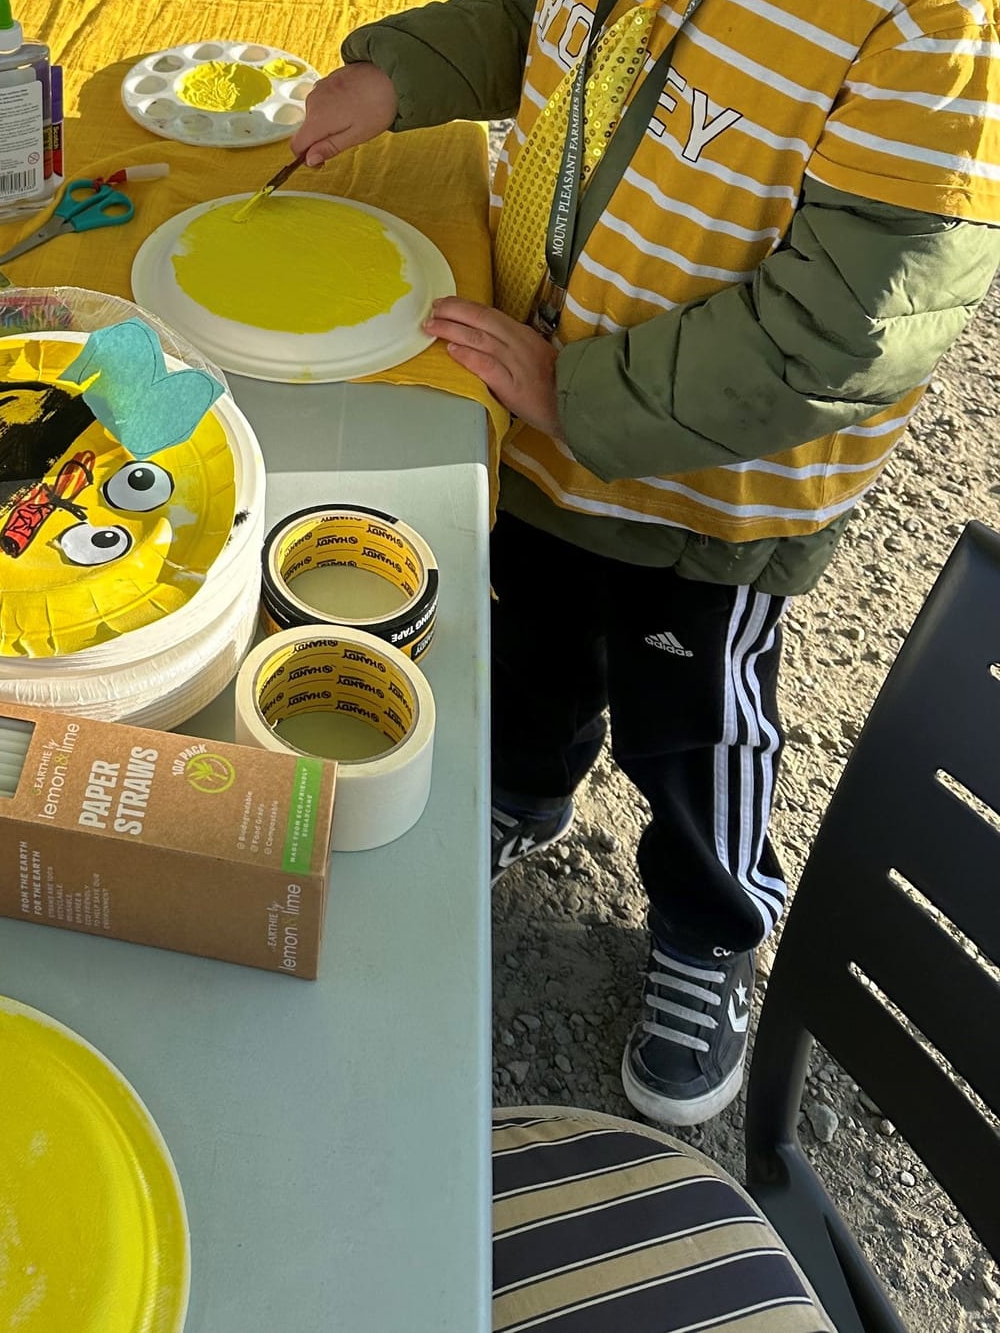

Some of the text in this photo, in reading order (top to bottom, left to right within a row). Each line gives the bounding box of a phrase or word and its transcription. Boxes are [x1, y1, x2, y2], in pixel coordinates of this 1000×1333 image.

[570, 96, 582, 152] FARMERS
[558, 153, 577, 213] PLEASANT
[552, 215, 566, 257] MOUNT
[316, 535, 348, 547] HANDY
[391, 625, 415, 643] TAPE
[644, 636, 694, 658] adidas
[342, 649, 379, 670] HANDY
[287, 666, 322, 683] HANDY
[336, 675, 377, 695] HANDY
[286, 691, 321, 707] HANDY
[335, 700, 373, 719] HANDY
[34, 750, 53, 789] EARTHIE
[172, 743, 208, 776] 100 PACK
[79, 760, 121, 829] PAPER
[113, 746, 159, 836] STRAWS
[251, 825, 262, 844] Food
[19, 841, 30, 913] FROM THE EARTH
[32, 850, 43, 916] FOR THE EARTH
